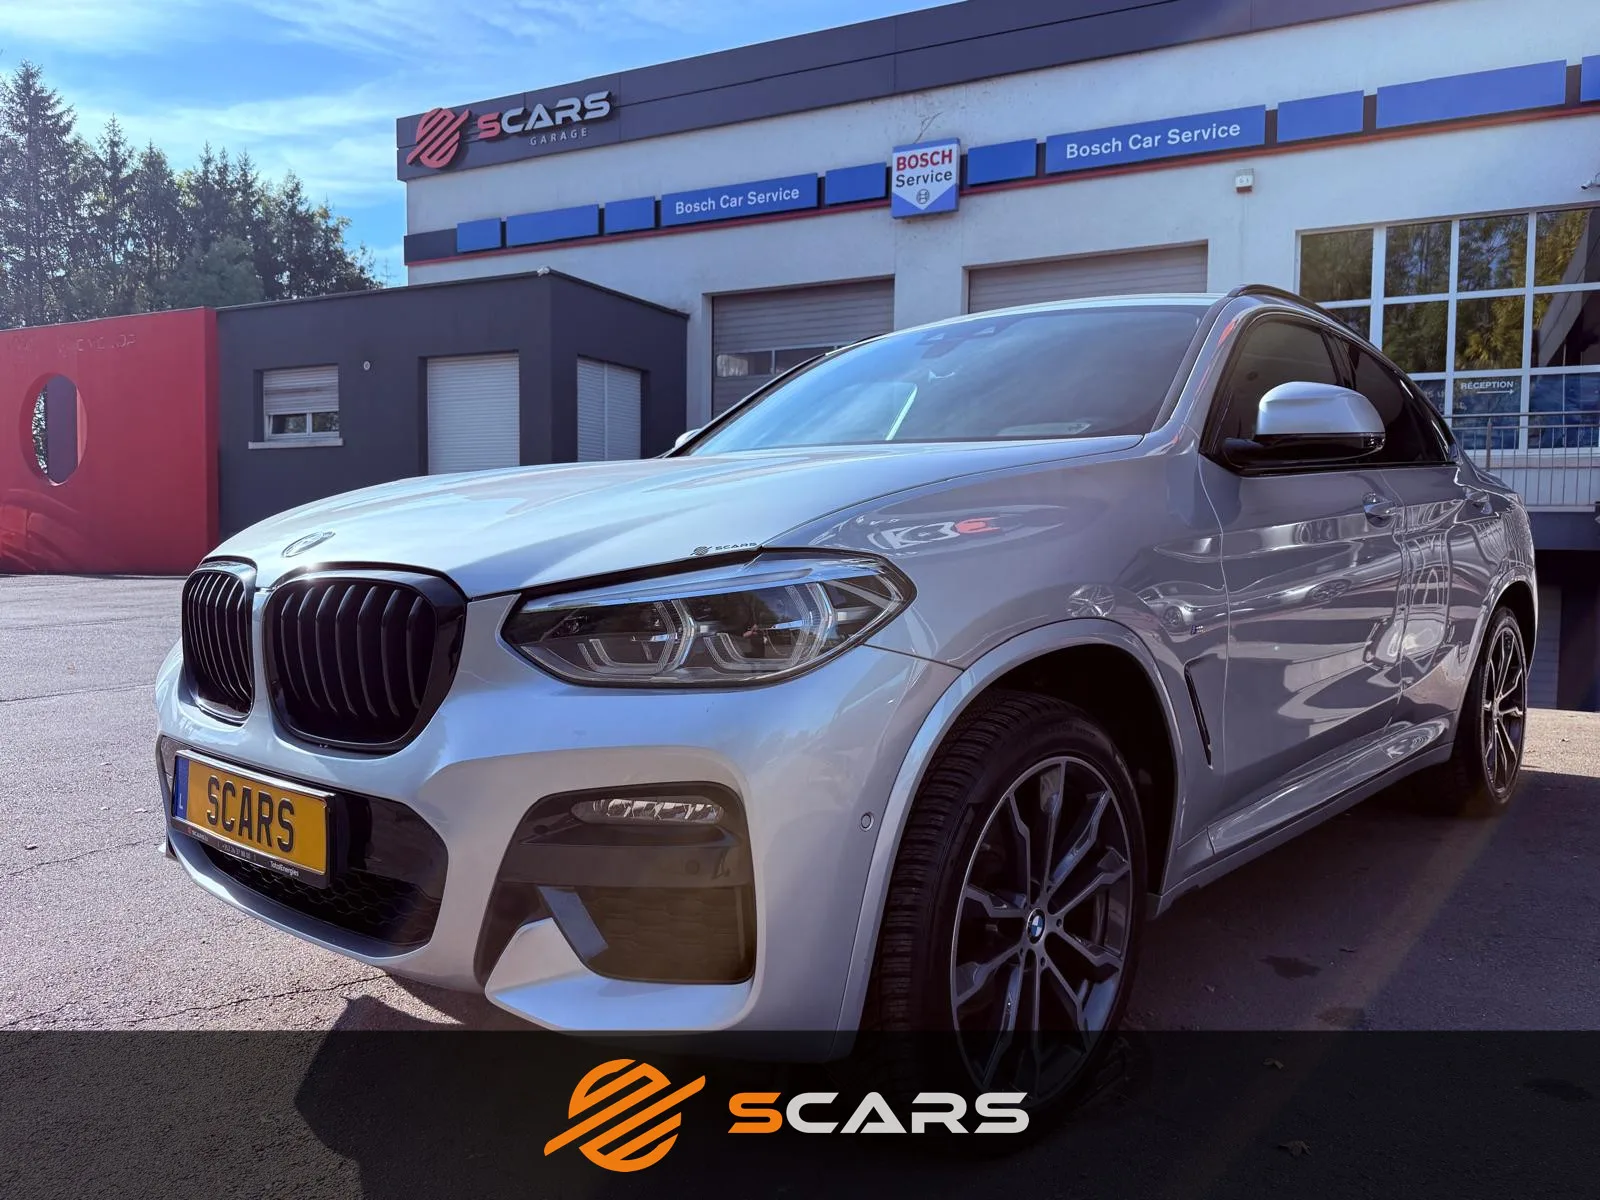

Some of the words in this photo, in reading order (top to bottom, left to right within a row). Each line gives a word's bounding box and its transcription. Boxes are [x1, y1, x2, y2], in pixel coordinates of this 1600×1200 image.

[477, 91, 610, 138] SCARS
[529, 127, 588, 146] GARAGE
[1066, 138, 1122, 159] Bosch
[1128, 133, 1161, 150] Car
[1167, 123, 1241, 144] Service
[897, 149, 952, 171] BOSCH
[896, 170, 952, 188] Service
[675, 198, 716, 215] Bosch
[719, 194, 743, 210] Car
[747, 187, 800, 204] Service
[715, 542, 757, 551] SCARS
[206, 775, 295, 853] SCARS
[270, 860, 299, 876] TotalEnergies
